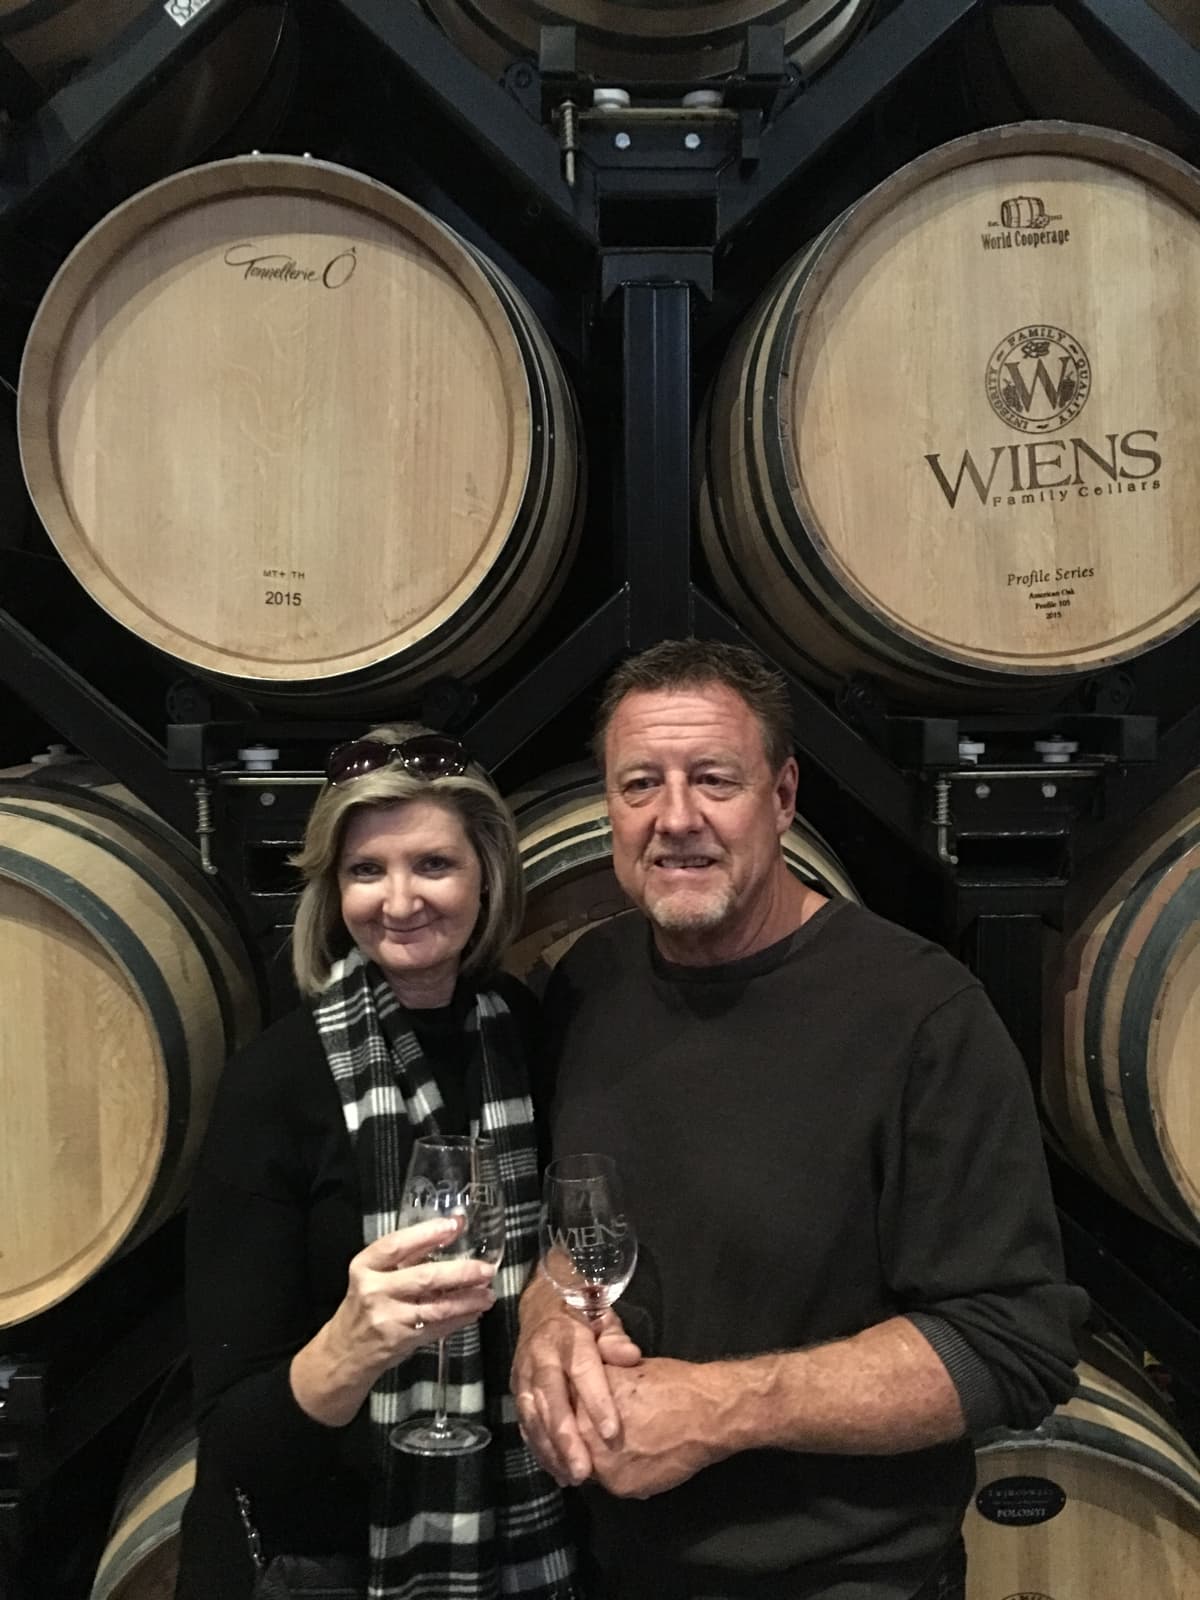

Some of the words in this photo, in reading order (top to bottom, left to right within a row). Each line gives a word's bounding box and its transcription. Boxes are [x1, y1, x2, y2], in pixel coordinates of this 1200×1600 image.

[981, 232, 1012, 250] World
[1015, 229, 1070, 248] Cooperage
[1007, 327, 1067, 347] FAMILY
[988, 366, 1029, 430] INTEGRITY
[1004, 355, 1073, 413] W
[1059, 357, 1090, 425] QUALITY
[923, 429, 1162, 510] WIENS
[993, 489, 1068, 507] Family
[1078, 479, 1161, 497] Cellars
[1007, 569, 1051, 588] Profile
[1055, 566, 1095, 581] Series
[264, 590, 302, 606] 2015
